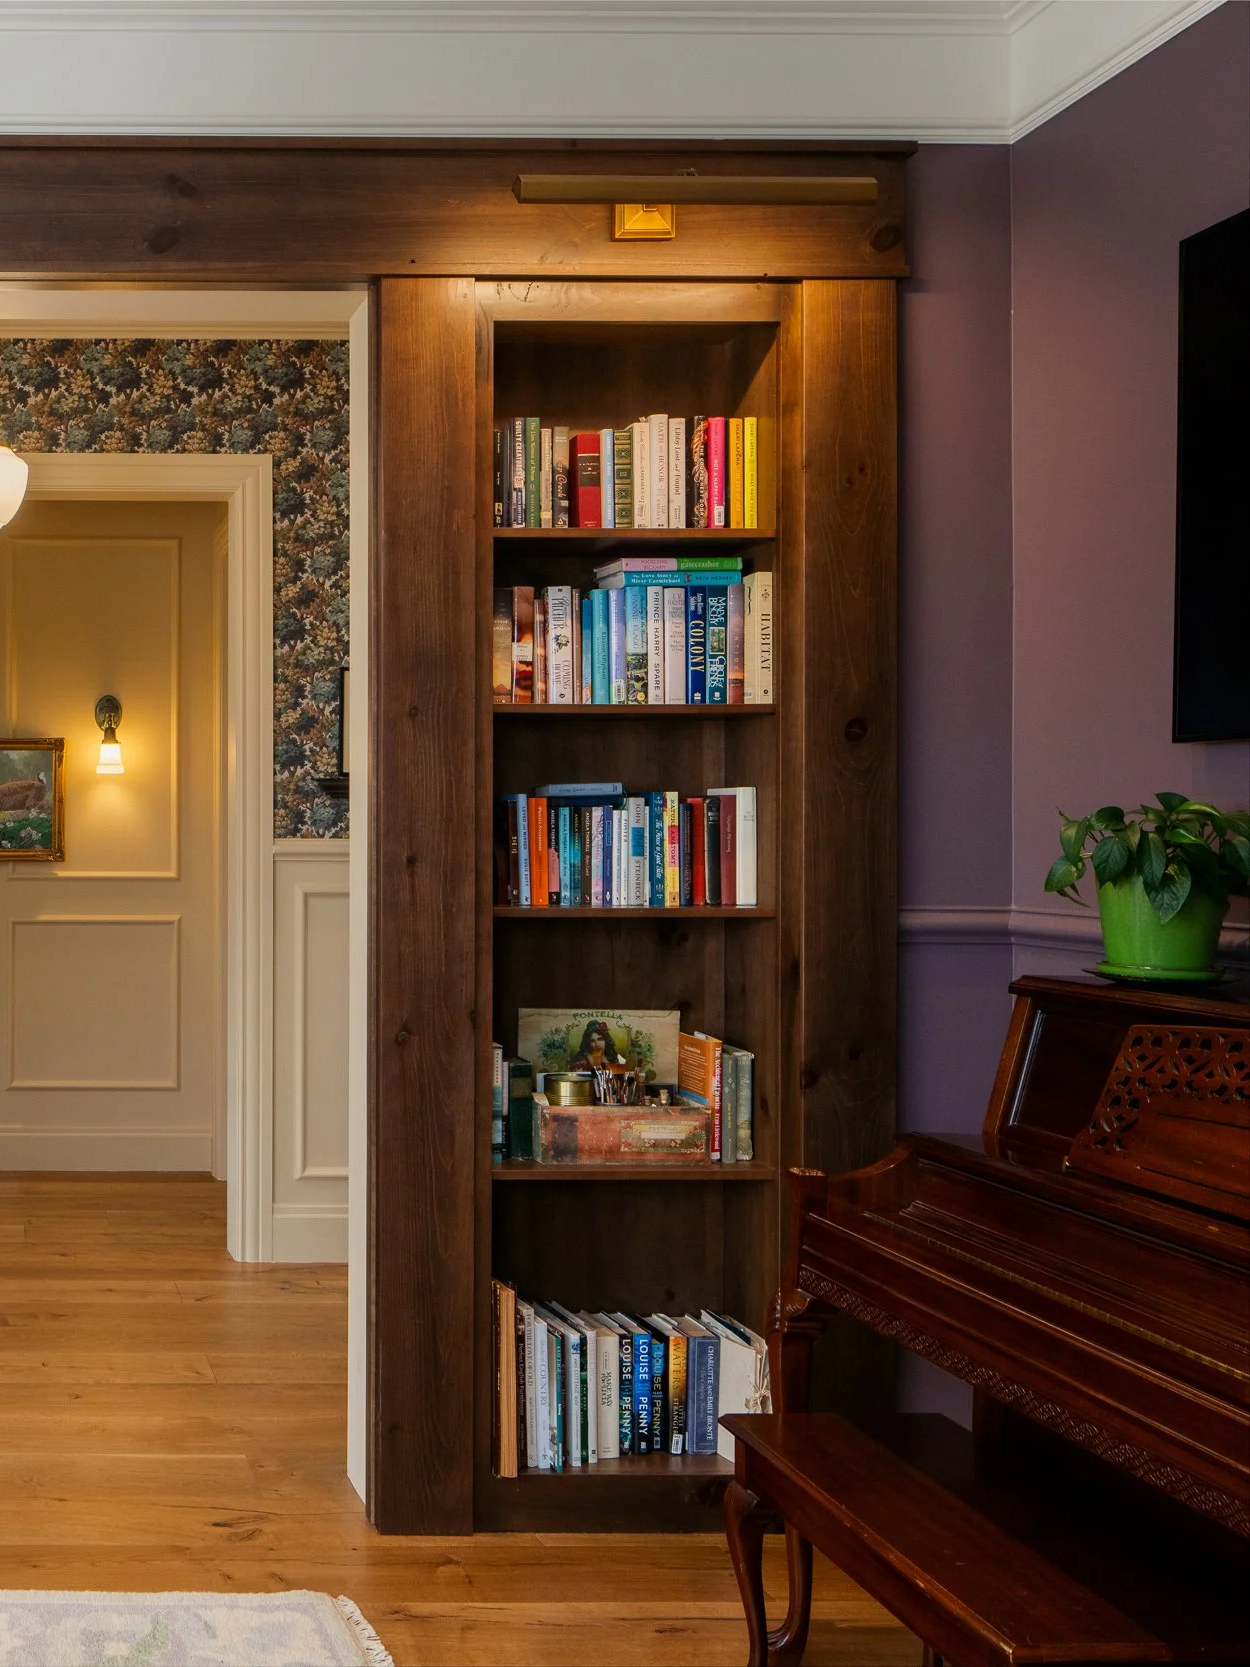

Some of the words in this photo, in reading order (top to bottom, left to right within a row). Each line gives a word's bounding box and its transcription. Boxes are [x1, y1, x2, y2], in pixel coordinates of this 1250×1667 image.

[556, 474, 567, 498] Creek
[680, 561, 719, 569] gatecrasher
[551, 598, 565, 629] PILCHER
[708, 597, 718, 625] BINCHY
[717, 597, 726, 622] MAEVE
[690, 620, 705, 673] COLONY
[761, 613, 771, 672] HABITAT
[562, 660, 571, 689] COMING
[708, 659, 717, 688] FRIENDS
[717, 656, 726, 682] CIRCLE
[654, 851, 662, 865] Good
[573, 1011, 623, 1021] FONTELLA
[622, 1339, 631, 1380] LOUISE
[639, 1339, 648, 1380] LOUISE
[653, 1351, 662, 1390] LOUISE
[672, 1343, 682, 1389] WATERS
[539, 1363, 547, 1407] COUNTRY
[622, 1396, 631, 1435] PENNY
[639, 1396, 648, 1435] PENNY
[652, 1399, 661, 1436] PENNY
